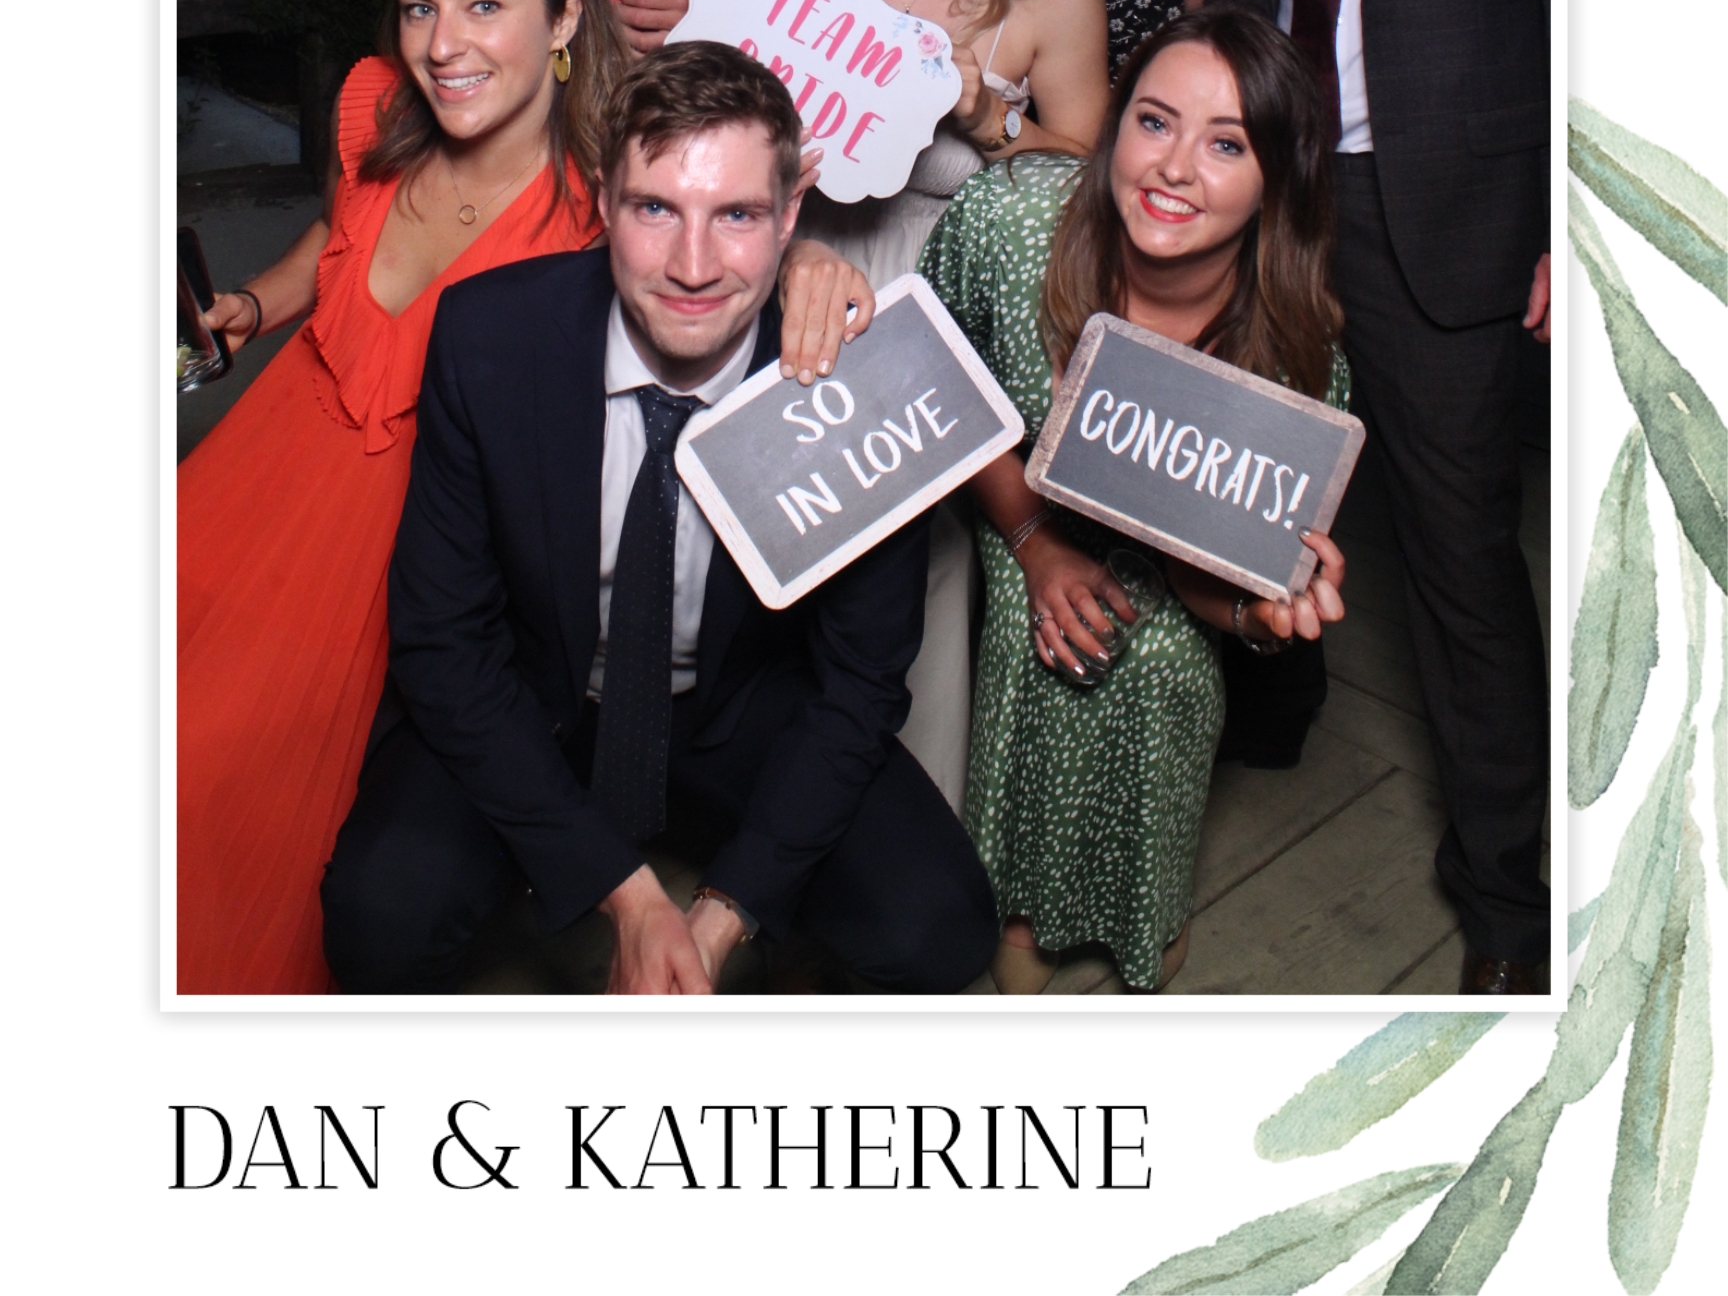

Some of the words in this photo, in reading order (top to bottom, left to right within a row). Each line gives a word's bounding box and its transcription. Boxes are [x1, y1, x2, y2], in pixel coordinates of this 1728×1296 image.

[775, 472, 842, 536] IN
[842, 388, 959, 489] LOVE
[782, 380, 855, 443] SO
[1080, 389, 1311, 531] CONGRATS!
